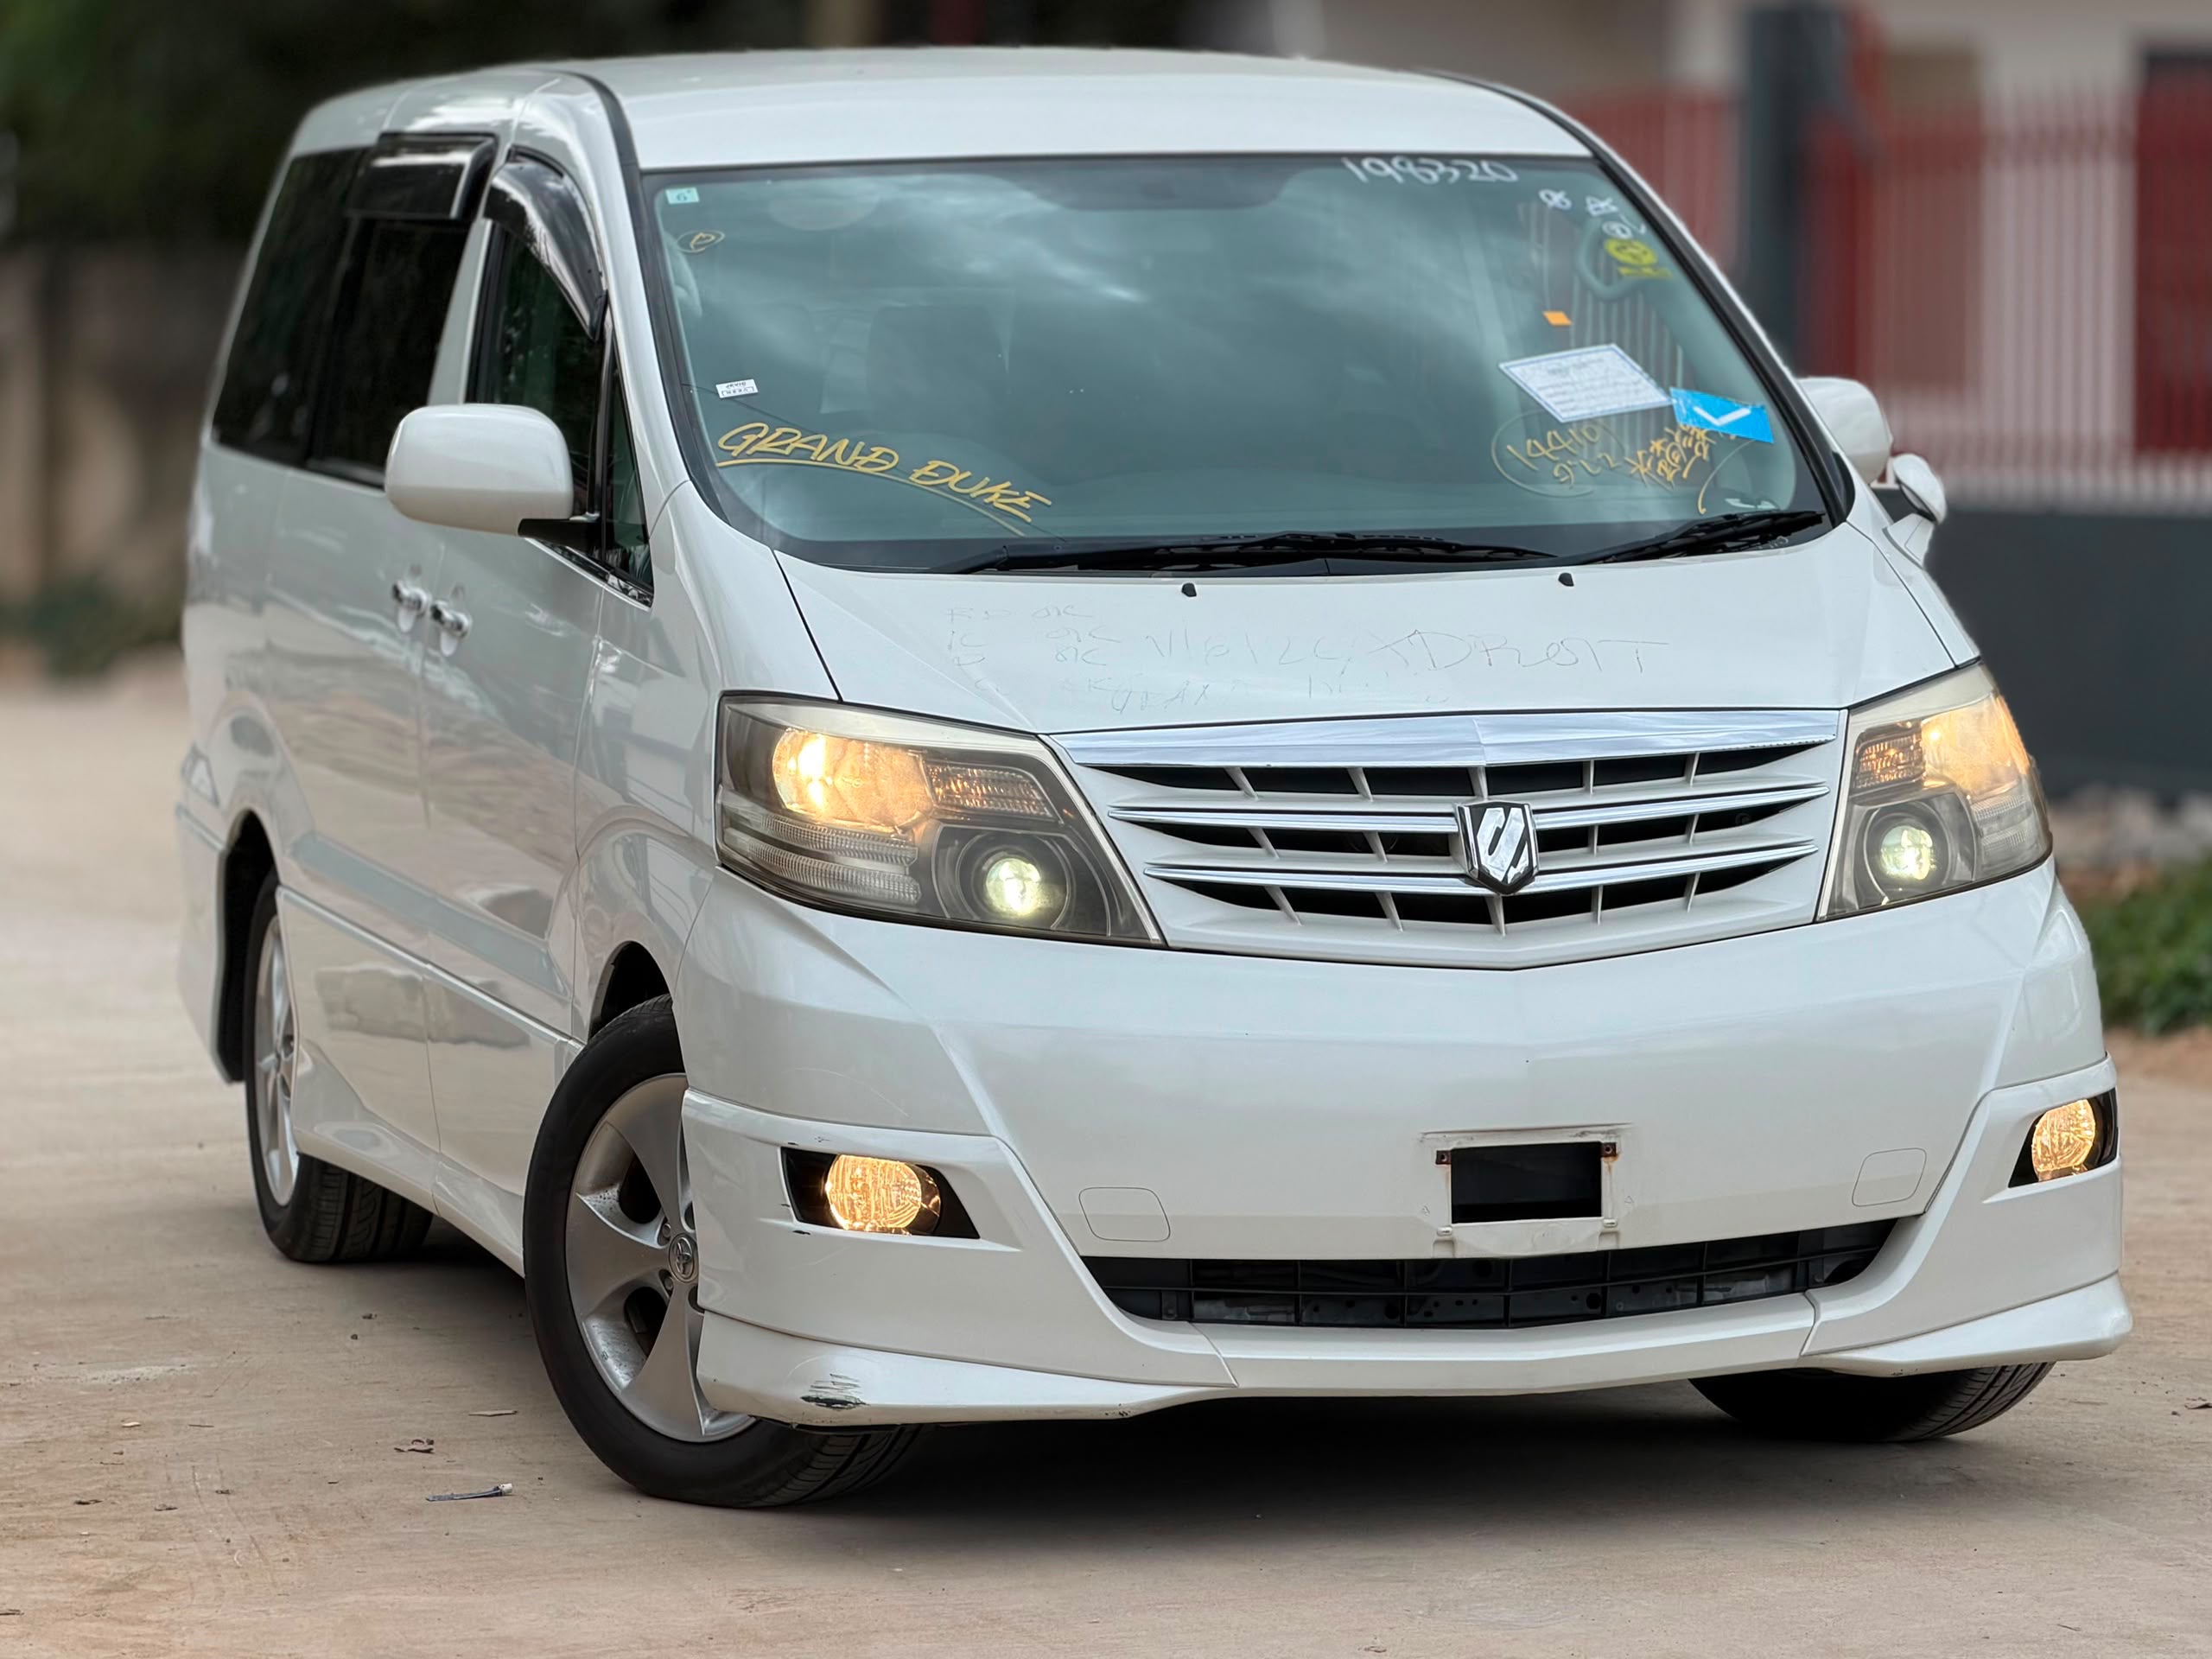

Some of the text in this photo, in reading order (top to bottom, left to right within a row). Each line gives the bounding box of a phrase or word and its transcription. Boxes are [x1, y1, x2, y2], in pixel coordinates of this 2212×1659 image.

[1340, 155, 1518, 185] 198320
[1506, 423, 1602, 471] 14410
[716, 422, 1053, 524] GRAND DUKE
